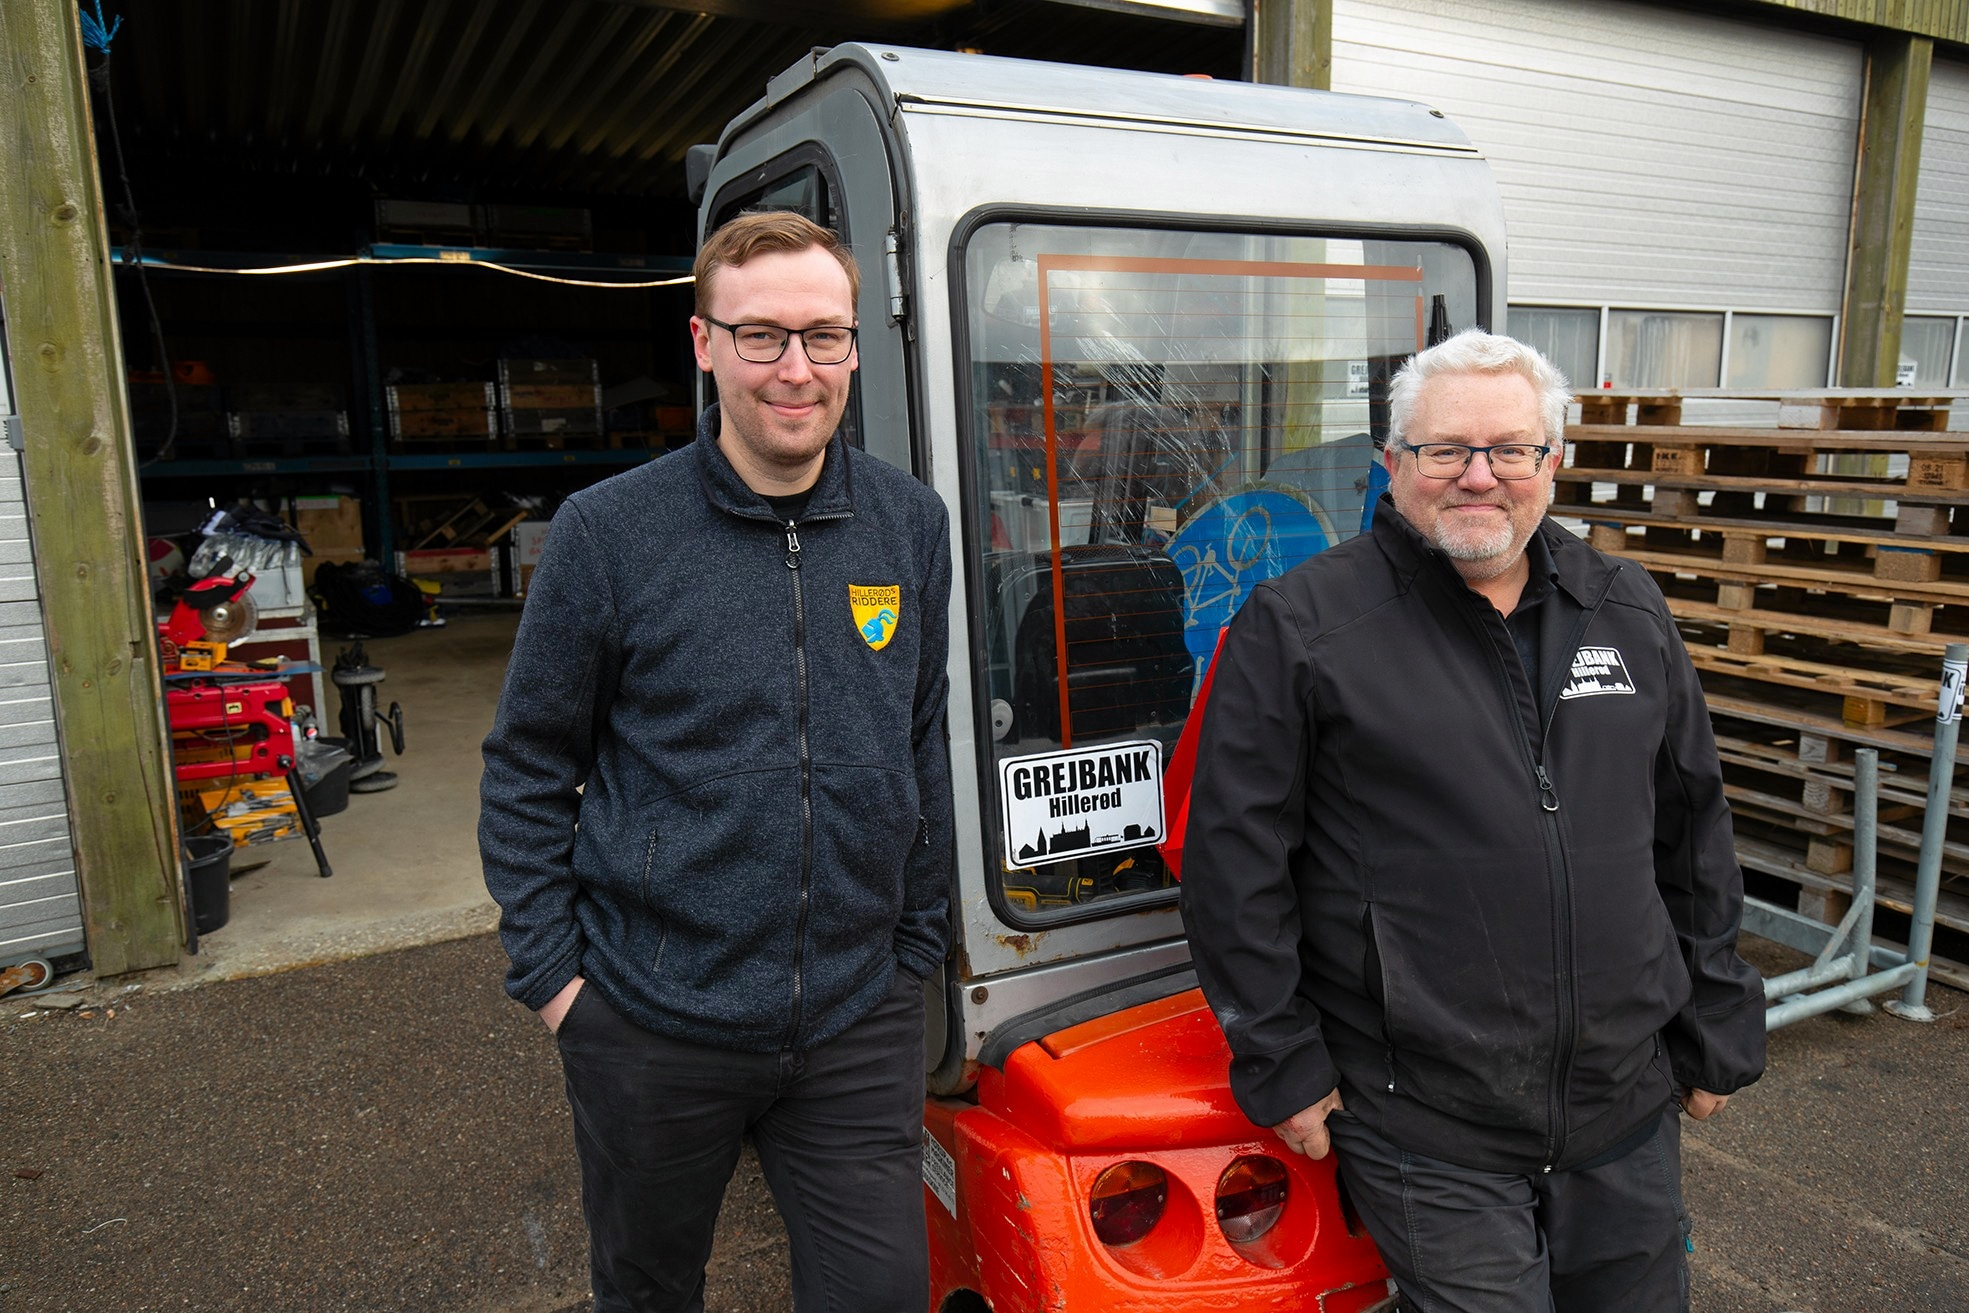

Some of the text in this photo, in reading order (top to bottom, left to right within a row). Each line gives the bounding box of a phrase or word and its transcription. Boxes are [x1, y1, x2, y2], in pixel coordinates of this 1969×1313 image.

[851, 597, 898, 606] RIDDERE
[1013, 750, 1152, 801] GREJBANK
[1049, 788, 1122, 818] Hillerød
